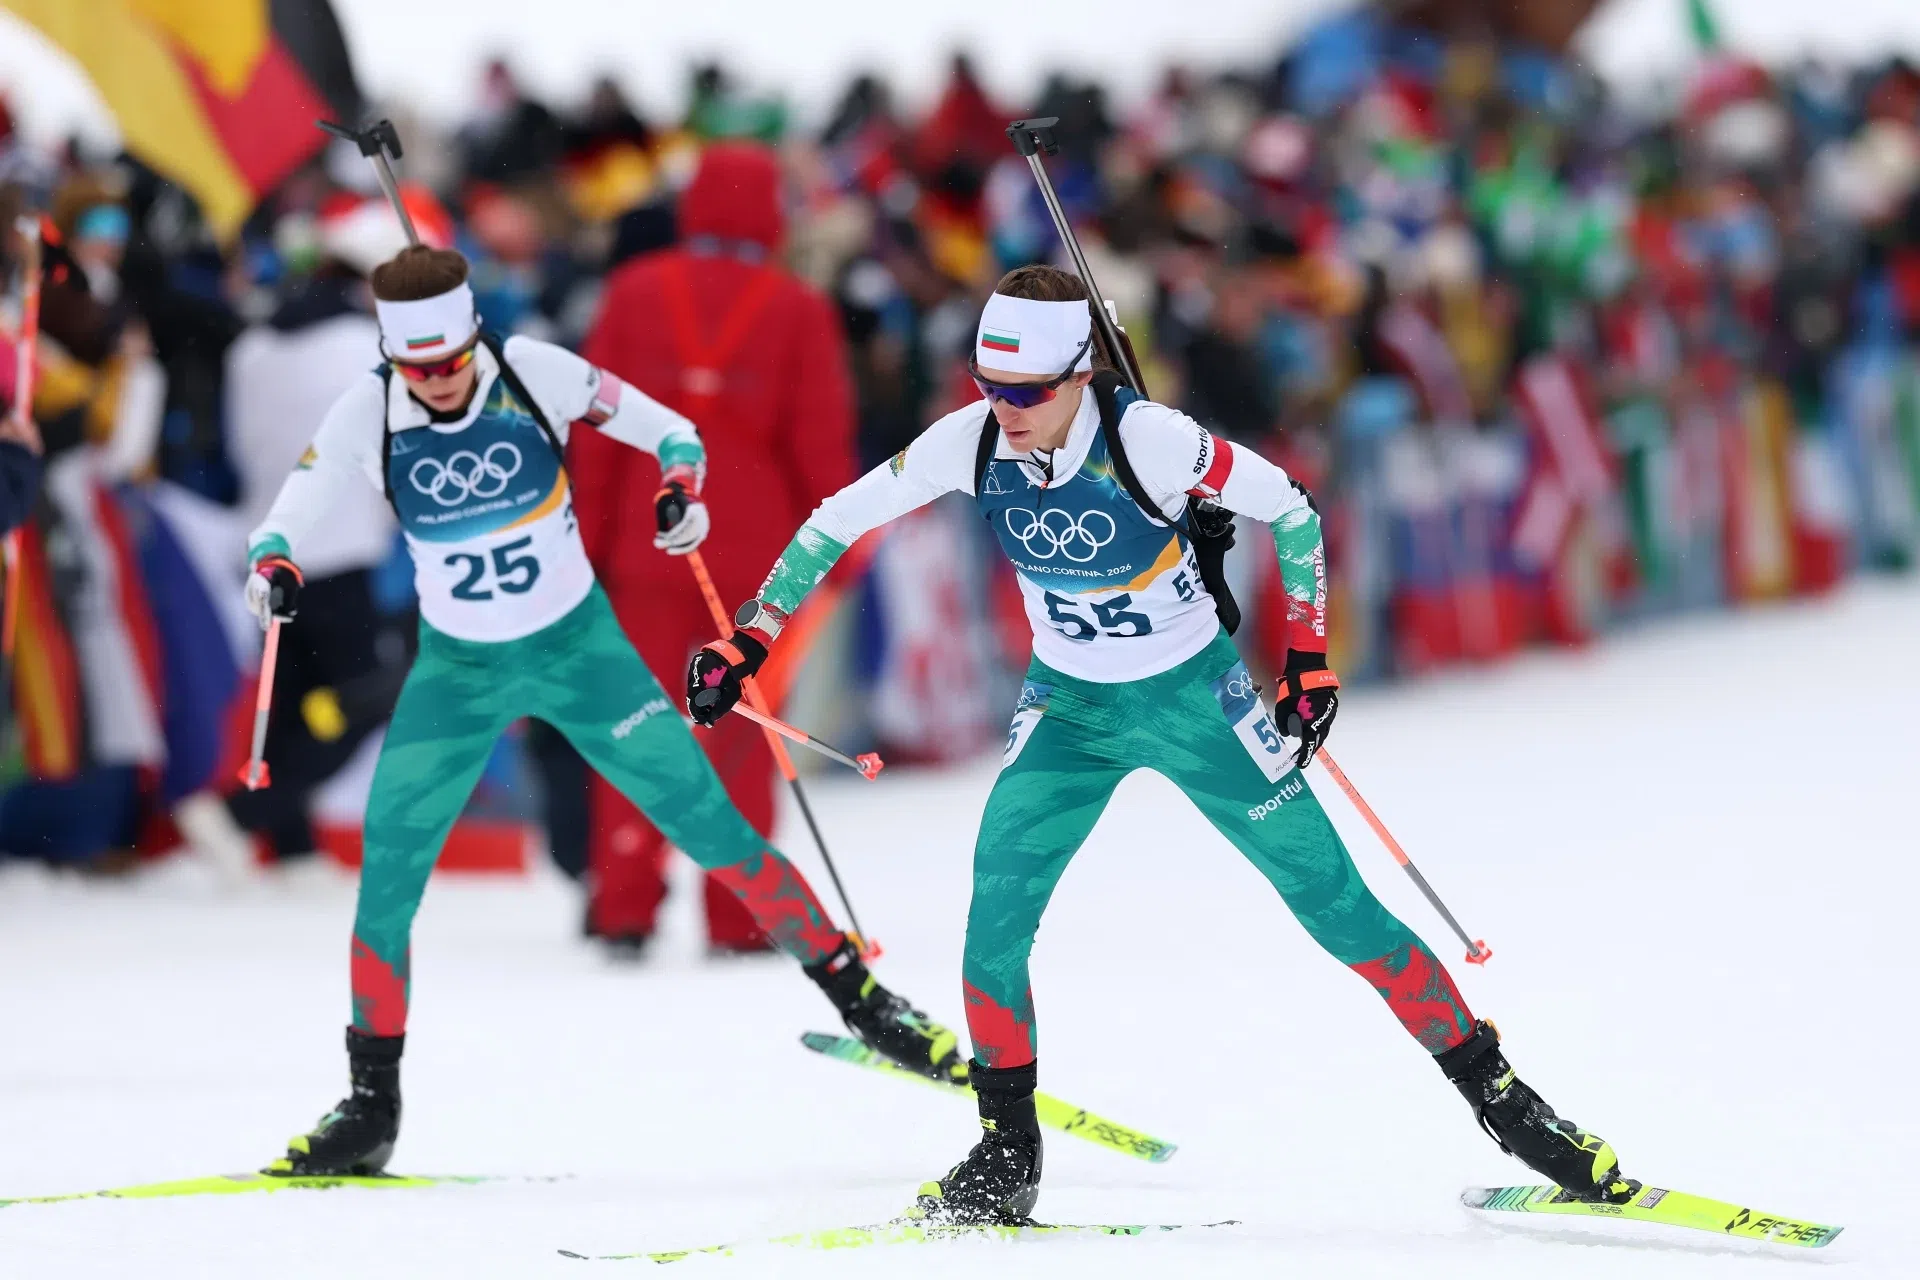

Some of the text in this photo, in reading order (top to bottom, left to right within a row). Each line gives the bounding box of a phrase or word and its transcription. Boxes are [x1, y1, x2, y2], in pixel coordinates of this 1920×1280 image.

[444, 535, 540, 601] 25
[1010, 558, 1132, 577] MILANO CORTINA 2026
[1044, 590, 1152, 641] 55
[1247, 778, 1303, 821] sportful
[1749, 1218, 1830, 1244] FISCHER
